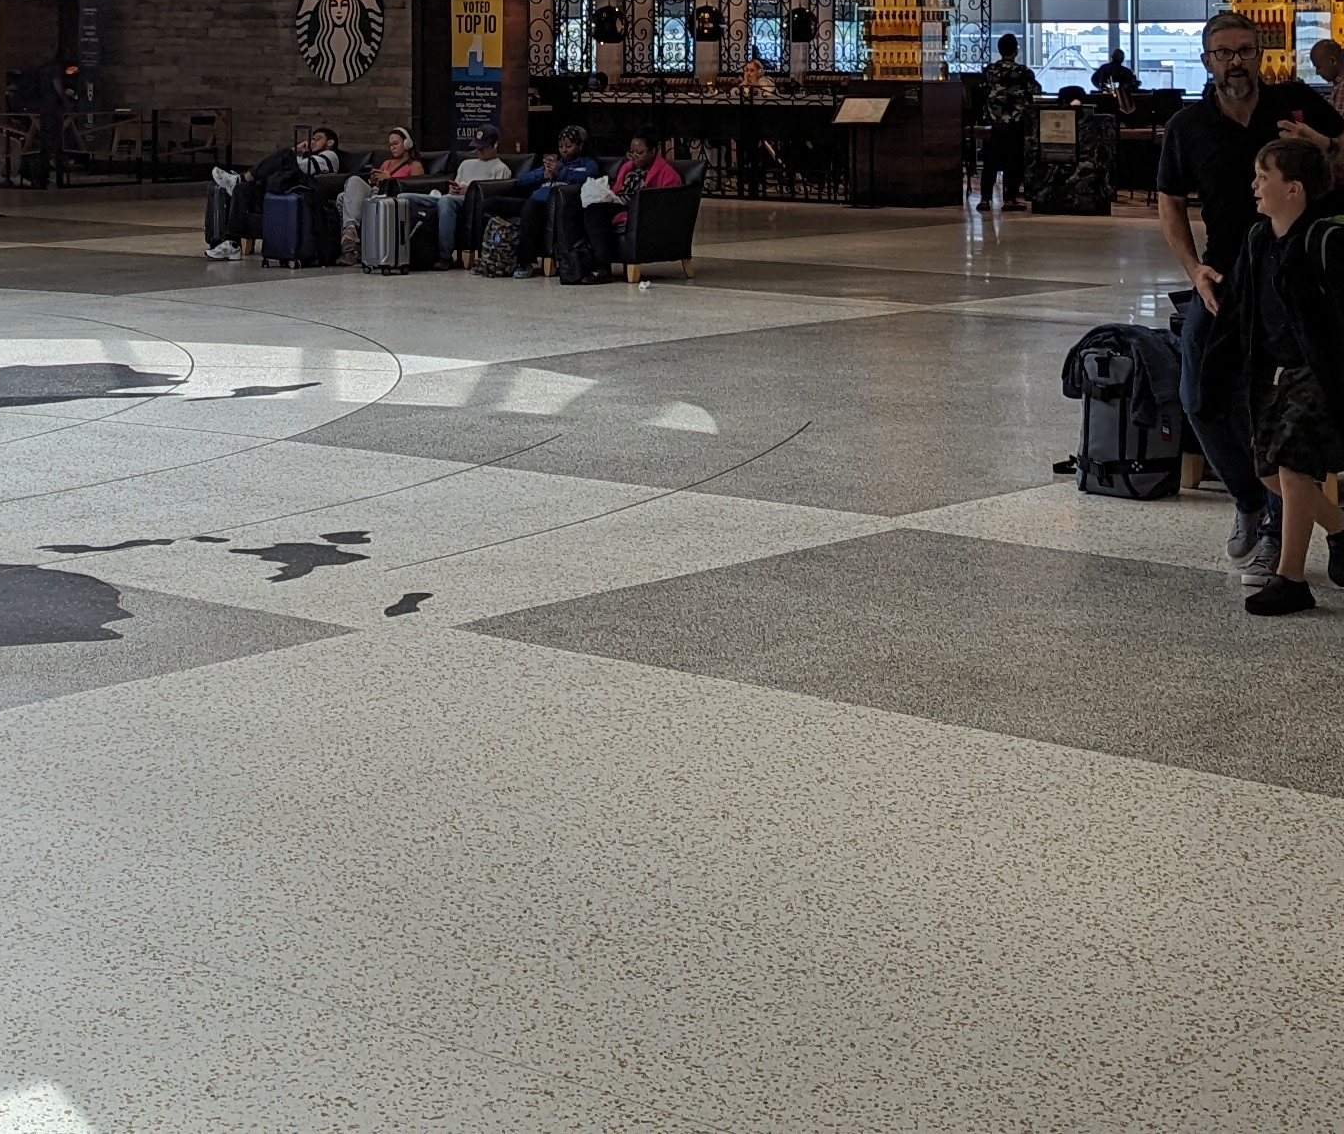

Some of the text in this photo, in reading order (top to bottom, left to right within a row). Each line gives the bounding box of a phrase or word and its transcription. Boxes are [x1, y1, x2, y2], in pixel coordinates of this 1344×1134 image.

[463, 1, 491, 13] VOTED
[456, 15, 497, 33] TOP 10
